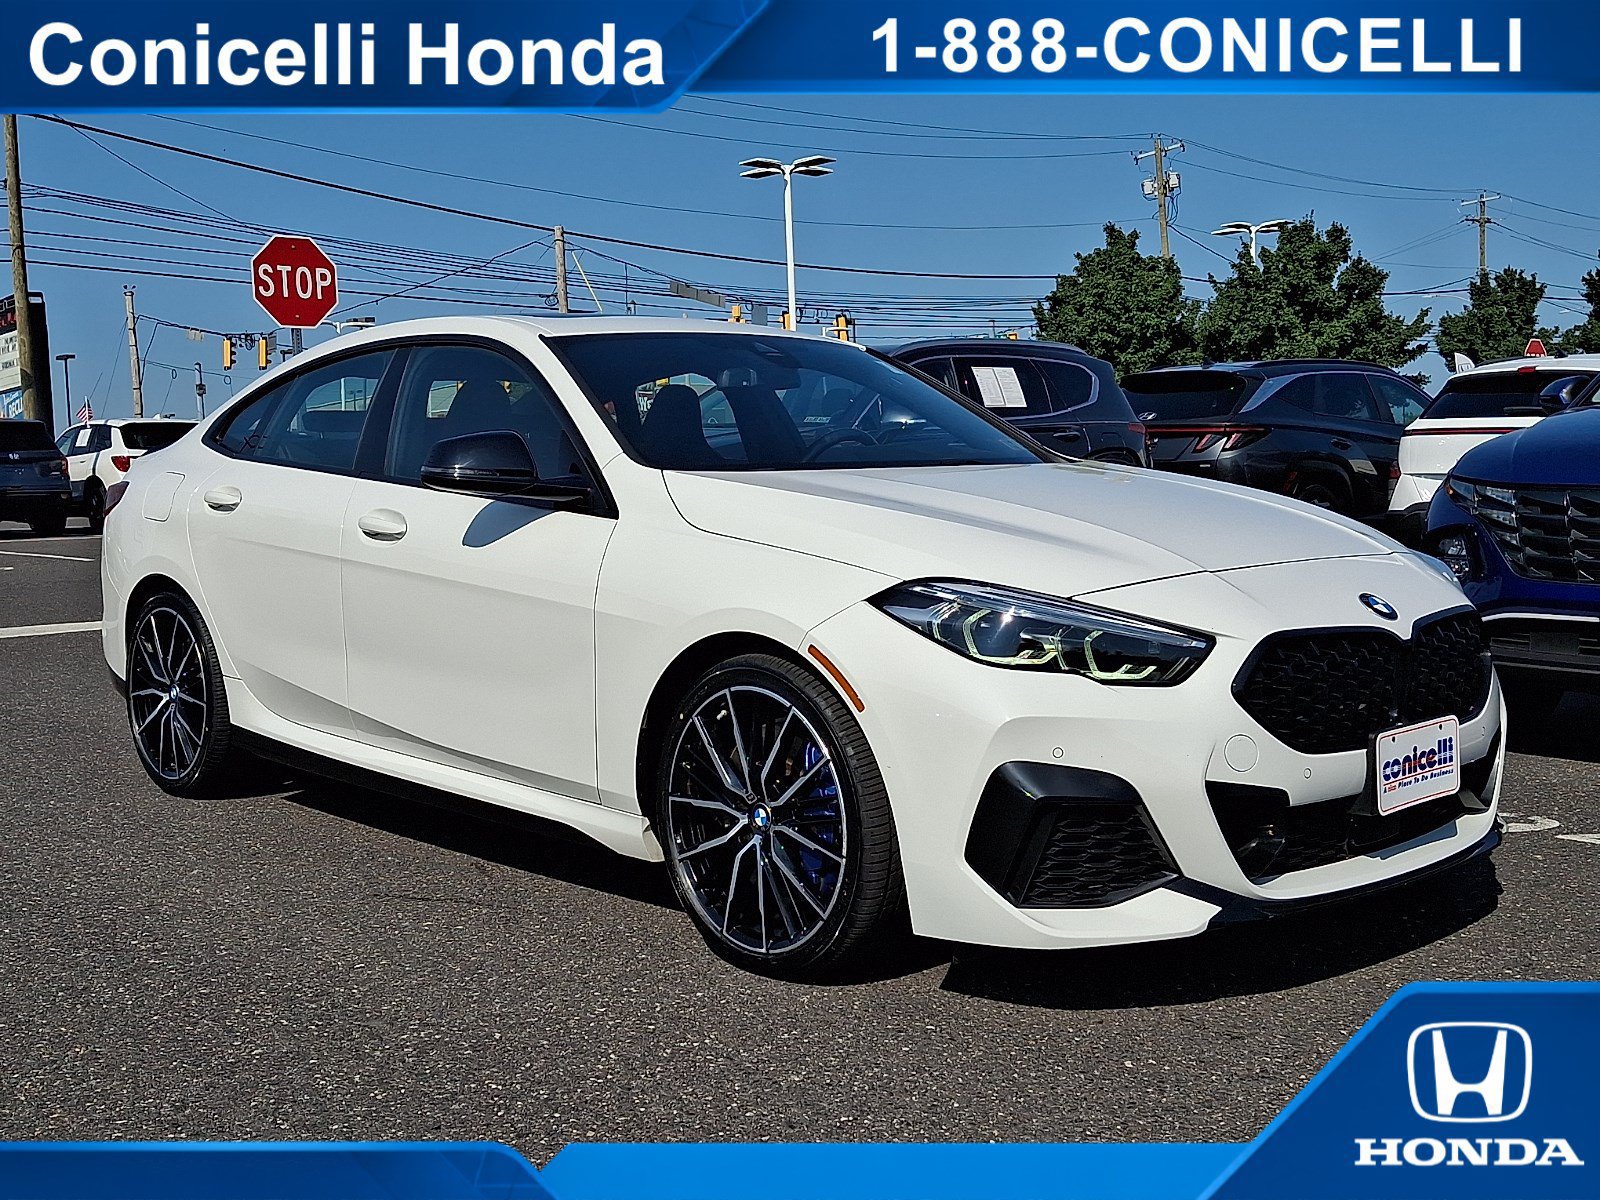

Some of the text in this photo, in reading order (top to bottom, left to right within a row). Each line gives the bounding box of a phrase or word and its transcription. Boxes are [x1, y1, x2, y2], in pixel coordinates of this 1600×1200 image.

[258, 263, 332, 300] STOP
[1382, 736, 1454, 782] conicelli
[1397, 779, 1413, 790] Place
[1413, 776, 1420, 784] To
[1421, 774, 1429, 782] Do
[1429, 767, 1454, 779] Business
